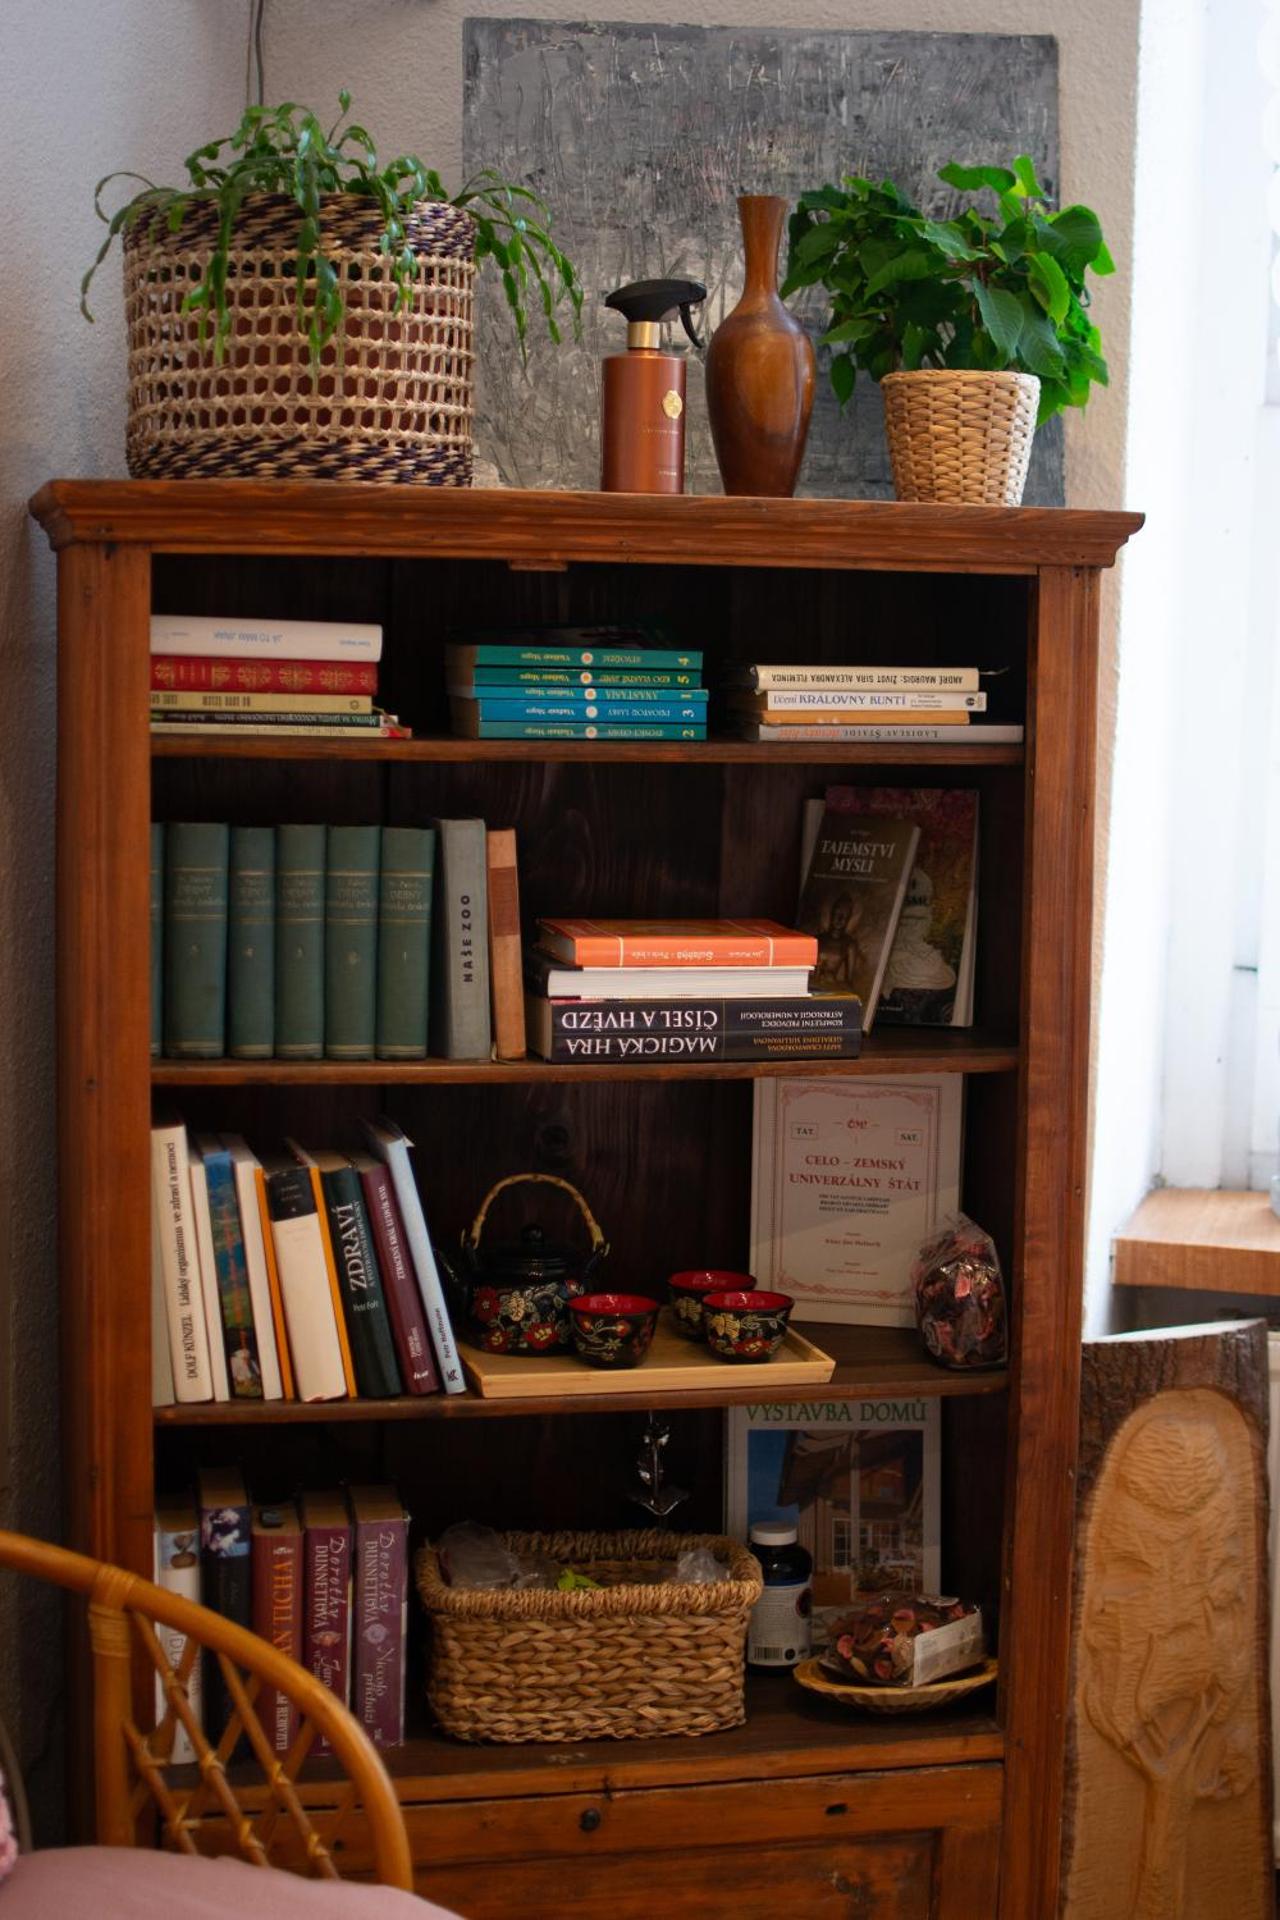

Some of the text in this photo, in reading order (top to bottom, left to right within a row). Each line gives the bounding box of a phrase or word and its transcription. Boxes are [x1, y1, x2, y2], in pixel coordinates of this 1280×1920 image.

[771, 673, 808, 683] FLEMINGA
[808, 673, 853, 683] ALEXANDRA
[855, 674, 874, 683] SIRA
[877, 674, 898, 685] ŽIVOT
[939, 675, 963, 685] ANDRÉ
[605, 690, 658, 700] ANASTASIA
[886, 730, 939, 739] LADISLAV
[820, 839, 897, 859] TAJEMSTVÍ
[831, 858, 875, 873] MYSLI
[460, 895, 473, 983] NAŠE ZOO
[561, 1010, 718, 1032] ČÍSEL A HVĚZD
[566, 1036, 718, 1057] MAGICKÁ HRA
[805, 1155, 840, 1166] CELO
[854, 1156, 906, 1171] ZEMSKÝ
[789, 1173, 922, 1191] UNIVERZÁLNY ŠTÁT
[331, 1203, 368, 1292] ZDRAVÍ
[860, 1398, 929, 1422] DOMŮ
[330, 1536, 346, 1619] Dorothy
